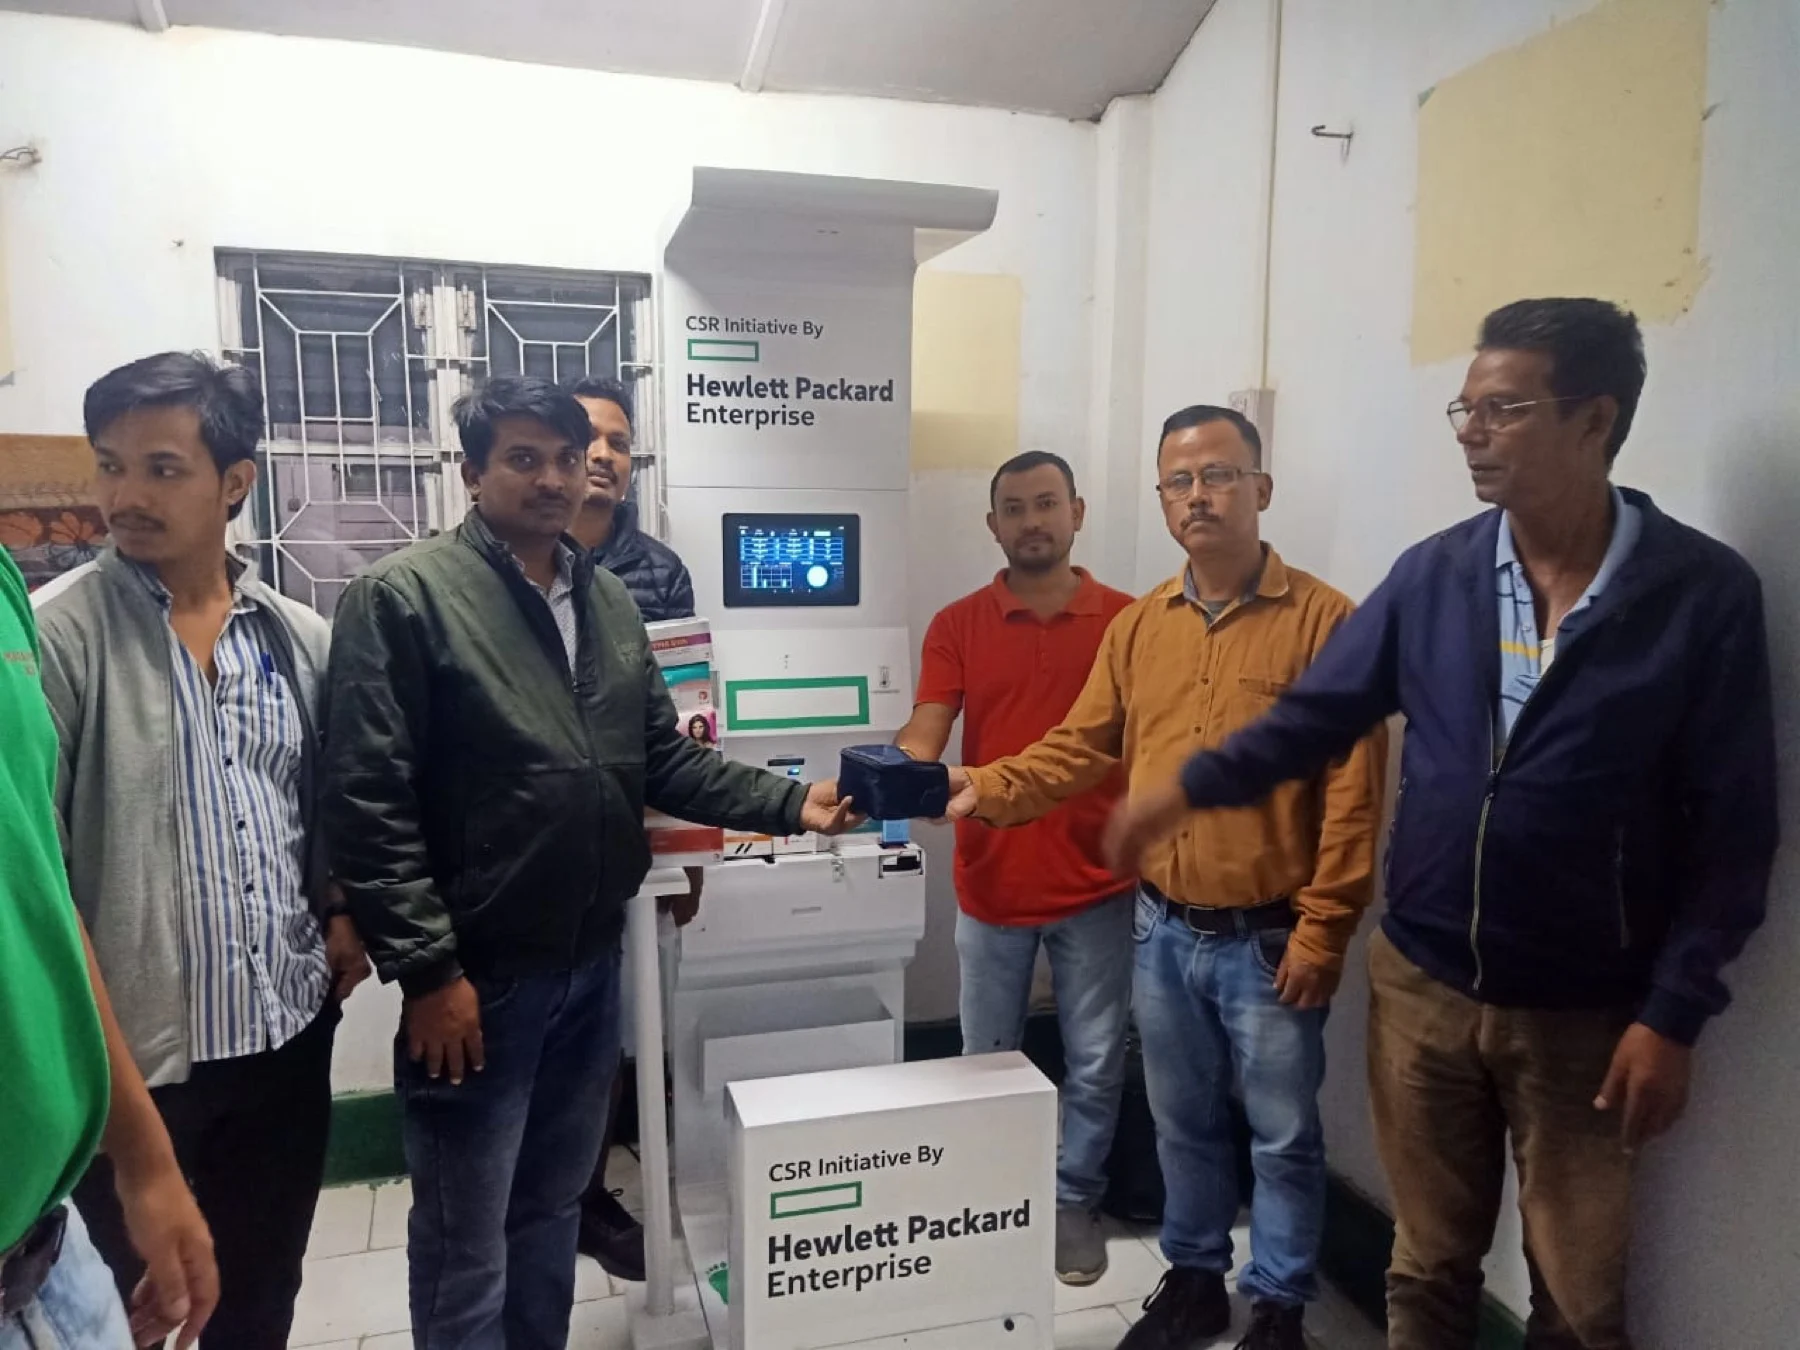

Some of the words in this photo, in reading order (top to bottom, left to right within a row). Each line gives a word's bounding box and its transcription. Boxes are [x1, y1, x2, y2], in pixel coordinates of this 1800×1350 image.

[686, 315, 721, 332] CSR
[725, 319, 799, 335] Initiative
[802, 320, 824, 340] By
[686, 373, 790, 399] Hewlett
[796, 376, 894, 402] Packard
[686, 402, 815, 431] Enterprise
[768, 1160, 812, 1182] CSR
[819, 1150, 913, 1177] Initiative
[917, 1145, 945, 1168] By
[768, 1220, 899, 1265] Hewlett
[908, 1198, 1031, 1244] Packard
[768, 1253, 932, 1299] Enterprise
